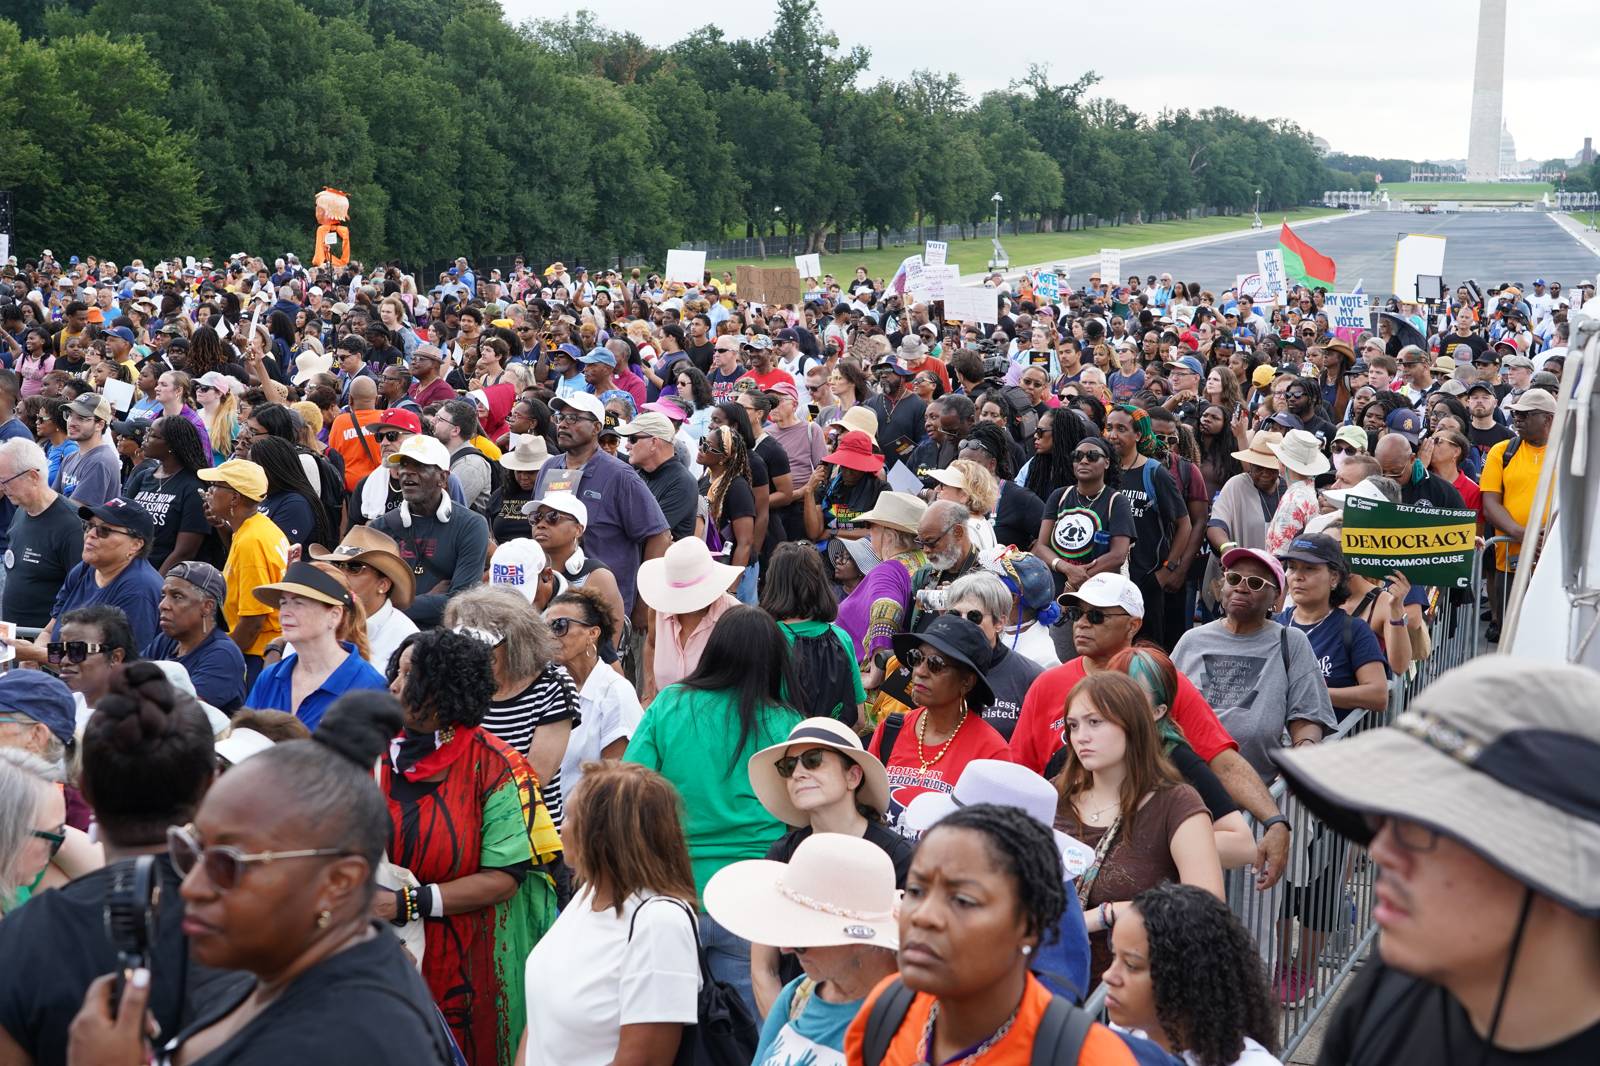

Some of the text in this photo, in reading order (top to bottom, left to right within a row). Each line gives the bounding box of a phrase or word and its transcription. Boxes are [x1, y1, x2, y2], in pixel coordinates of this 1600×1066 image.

[927, 242, 945, 250] VOTE
[1264, 260, 1279, 272] VOTE
[1038, 271, 1058, 286] VOTE
[1268, 271, 1277, 281] MY
[1037, 286, 1058, 299] VOICE
[1325, 295, 1338, 306] MY
[1340, 296, 1363, 308] VOTE
[1339, 307, 1354, 317] MY
[1334, 316, 1364, 327] VOICE
[156, 493, 177, 503] NOW
[1396, 504, 1477, 518] TEXT CAUSE TO 95559
[1345, 530, 1471, 549] DEMOCRACY
[1351, 554, 1465, 567] IS OUR COMMON CAUSE
[493, 563, 524, 576] BIDEN
[1213, 660, 1252, 670] NATIONAL
[1212, 669, 1246, 677] MUSEUM
[1210, 677, 1245, 686] AFRICAN
[1210, 683, 1253, 692] AMERICAN
